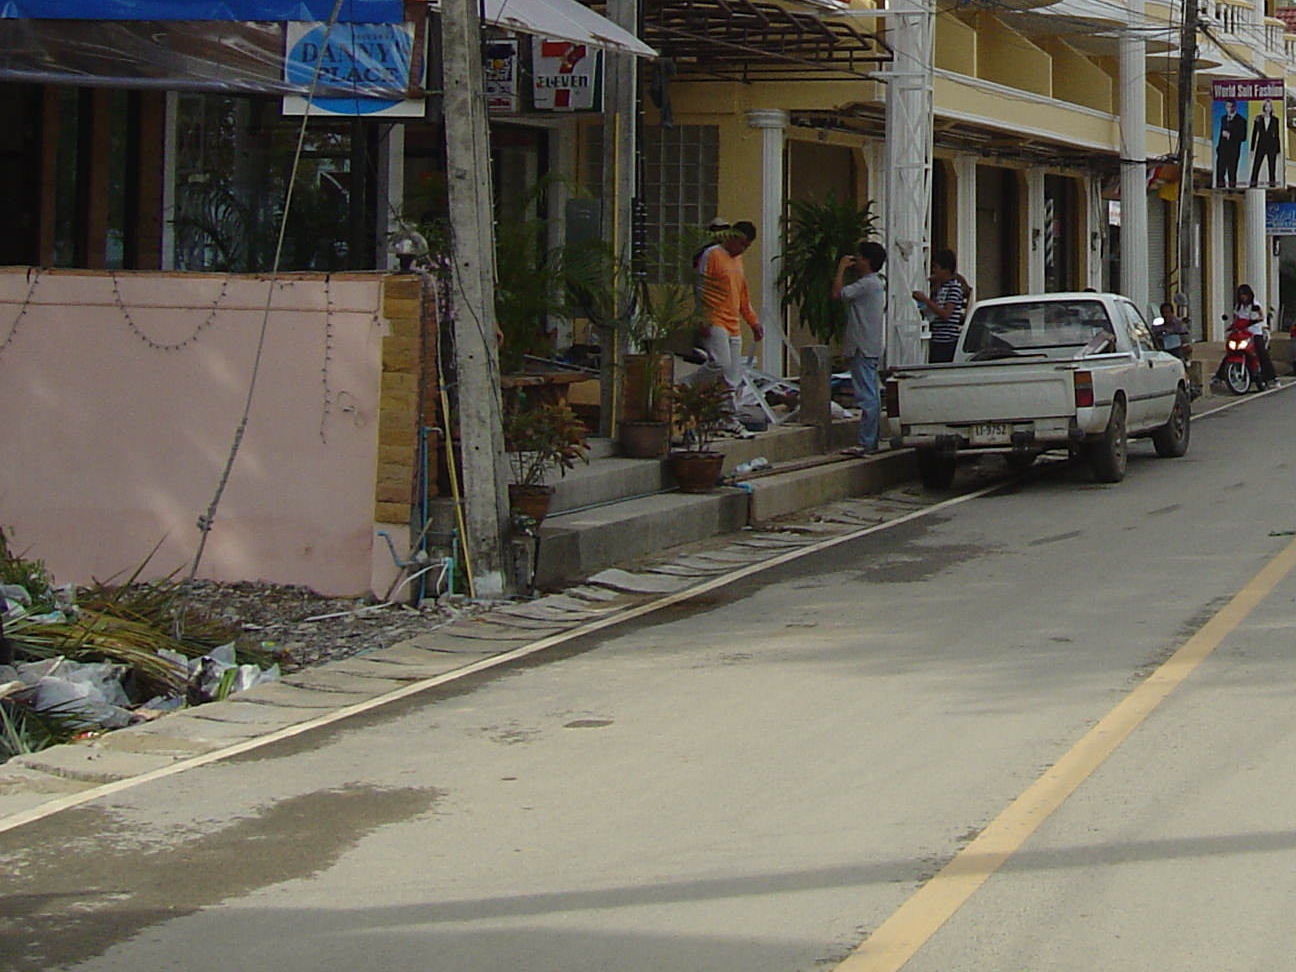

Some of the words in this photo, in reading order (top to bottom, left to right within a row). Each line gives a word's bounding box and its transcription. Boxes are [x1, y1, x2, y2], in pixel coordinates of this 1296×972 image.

[541, 41, 586, 107] 7
[1214, 84, 1236, 97] World
[1237, 84, 1252, 97] Suit
[1254, 84, 1283, 97] Fashion
